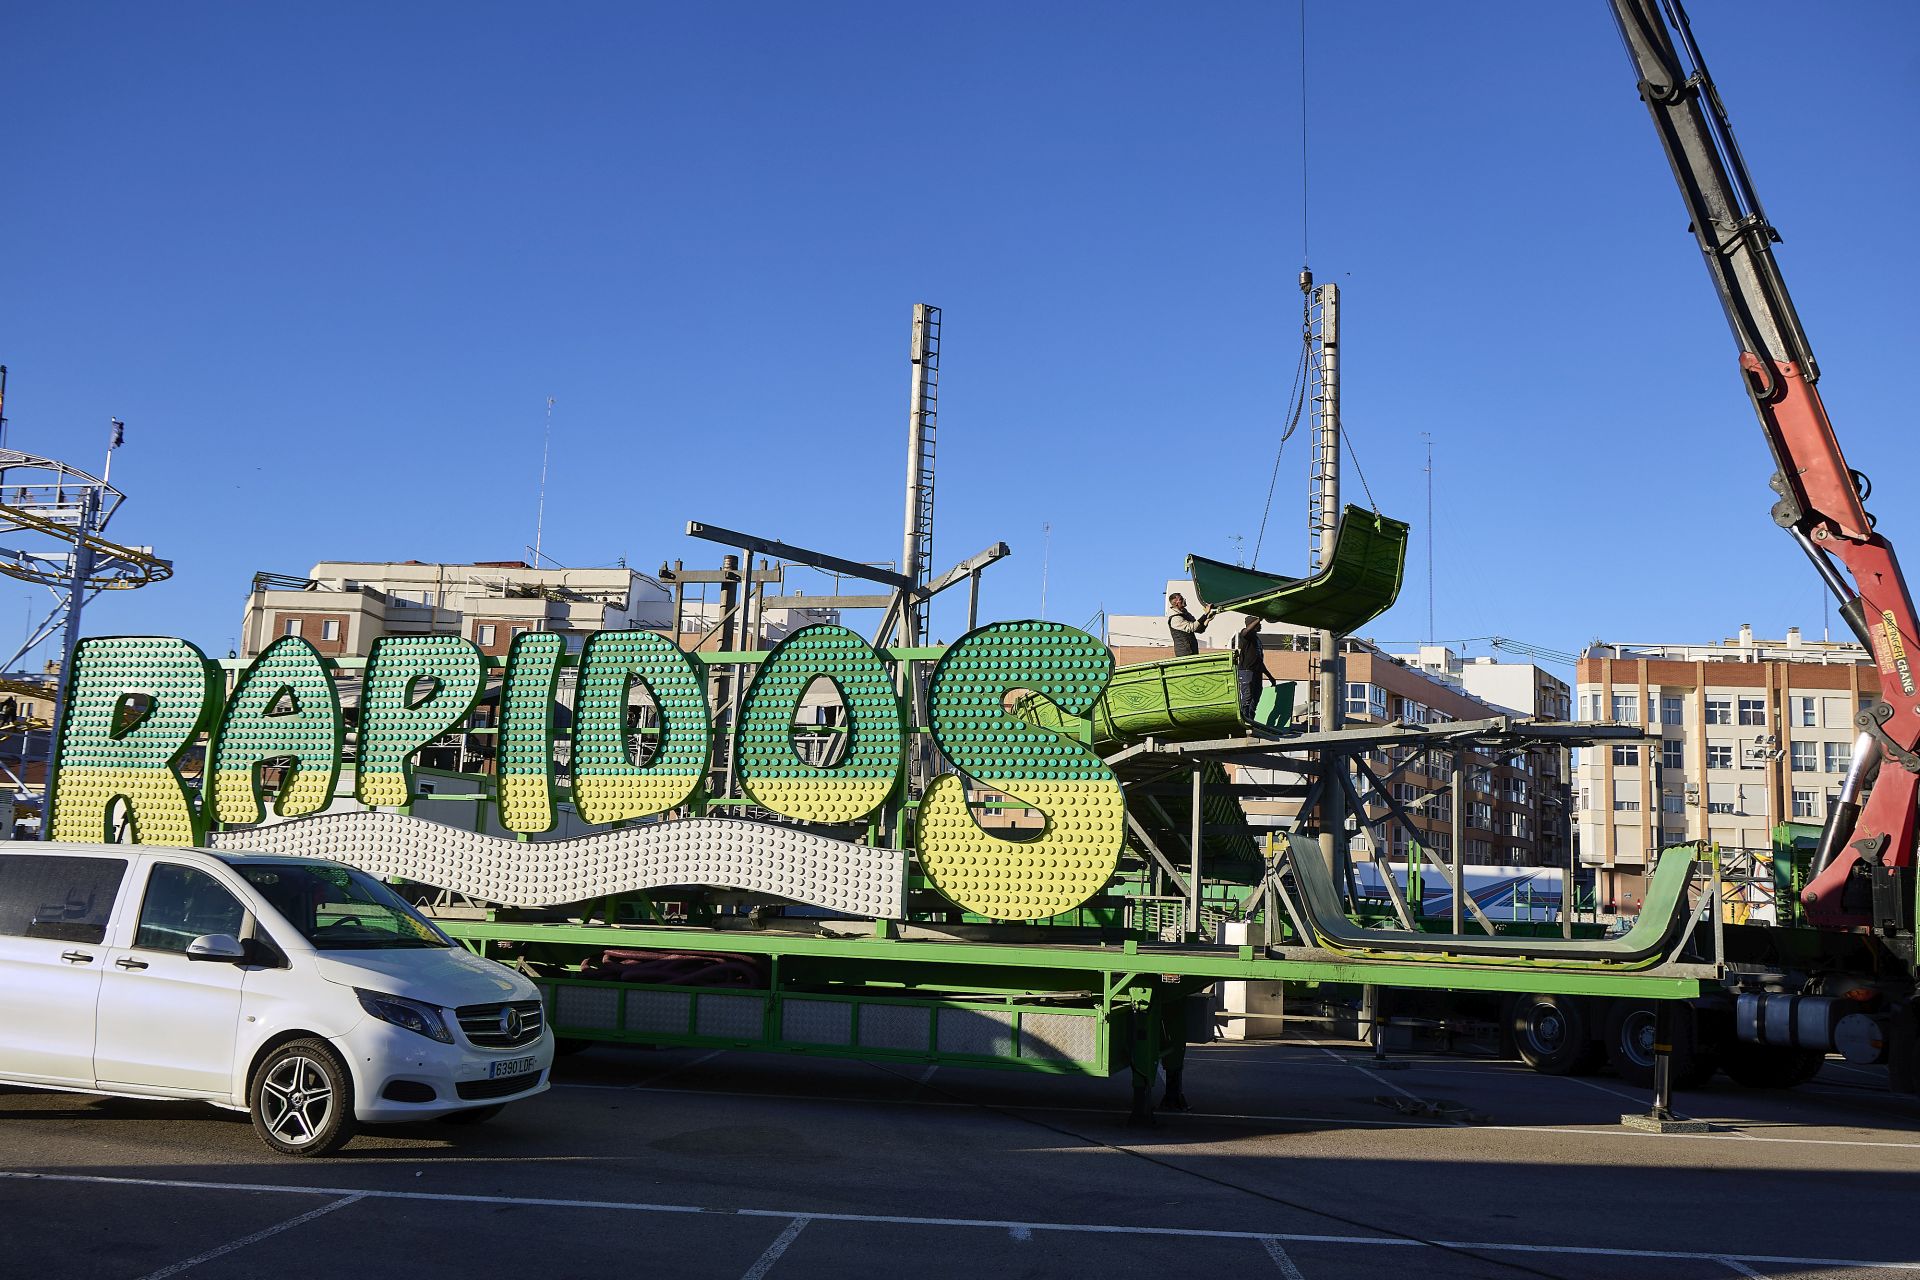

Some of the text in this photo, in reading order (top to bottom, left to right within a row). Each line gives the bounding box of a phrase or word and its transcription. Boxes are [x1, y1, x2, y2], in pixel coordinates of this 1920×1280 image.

[1884, 612, 1914, 693] PAFINGER CRANE
[48, 619, 1127, 920] RAPIDOS
[496, 1061, 518, 1076] 6390
